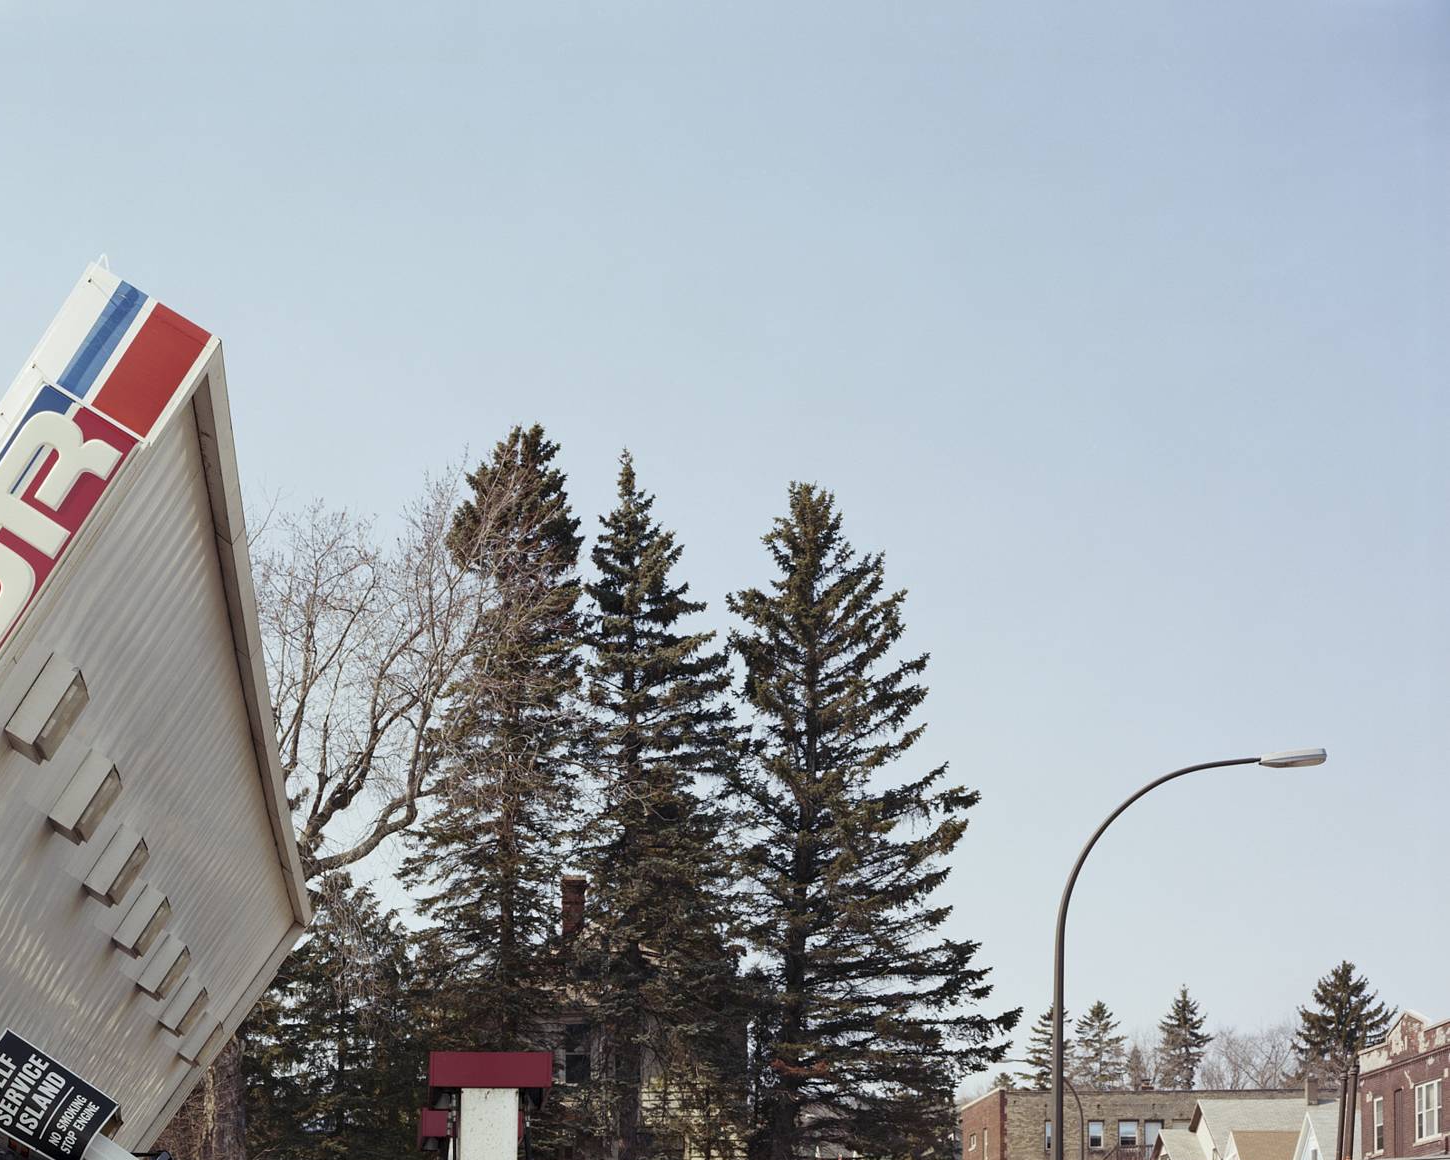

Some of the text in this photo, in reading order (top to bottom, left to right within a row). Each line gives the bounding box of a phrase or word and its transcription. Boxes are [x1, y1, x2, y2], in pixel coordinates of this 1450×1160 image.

[15, 1071, 66, 1136] ISLAND
[48, 1094, 88, 1146] NO SMOKING
[60, 1101, 100, 1155] STOP ENGINE
